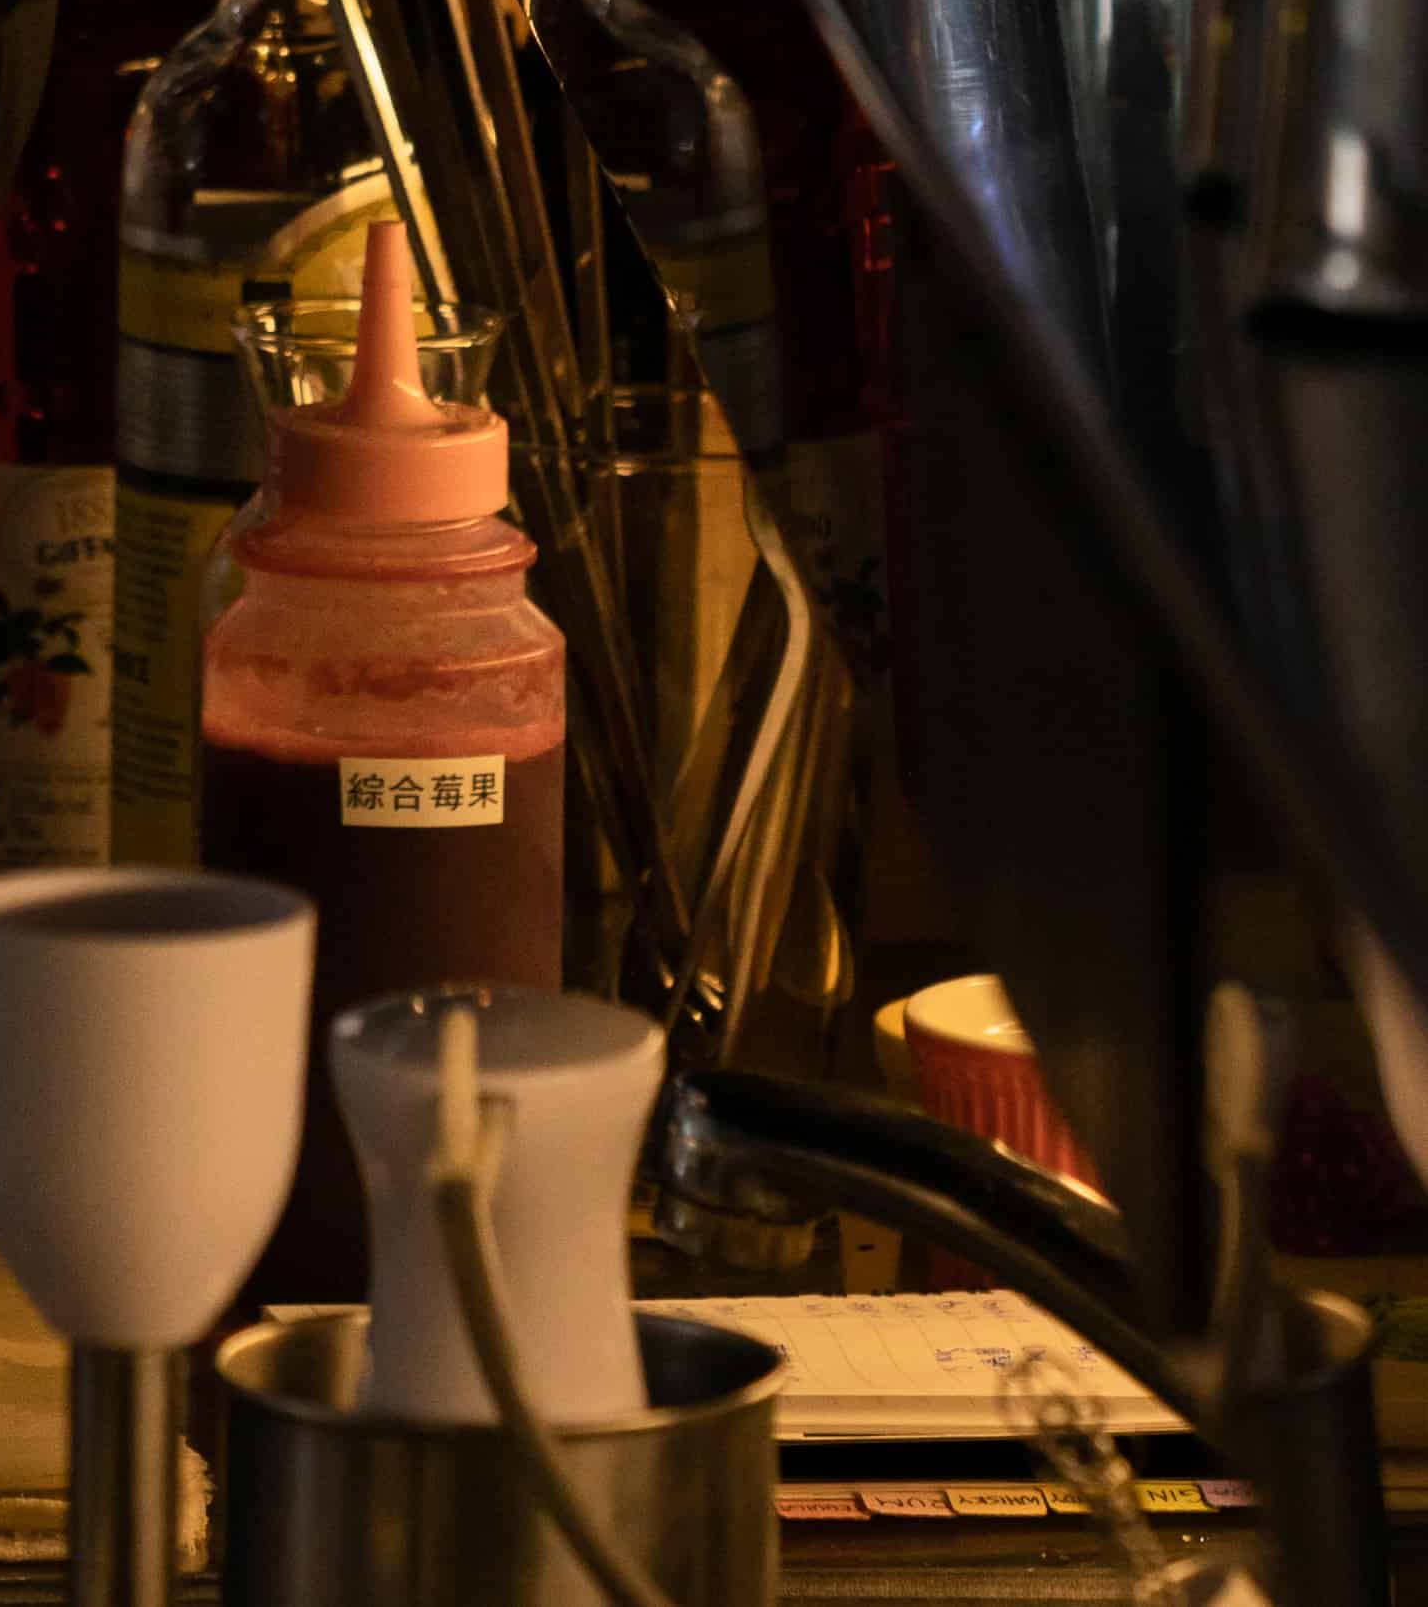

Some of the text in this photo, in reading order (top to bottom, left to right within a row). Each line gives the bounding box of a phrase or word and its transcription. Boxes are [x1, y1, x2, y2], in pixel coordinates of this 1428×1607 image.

[345, 772, 499, 812] 綜合莓果
[1146, 1488, 1202, 1504] GIN
